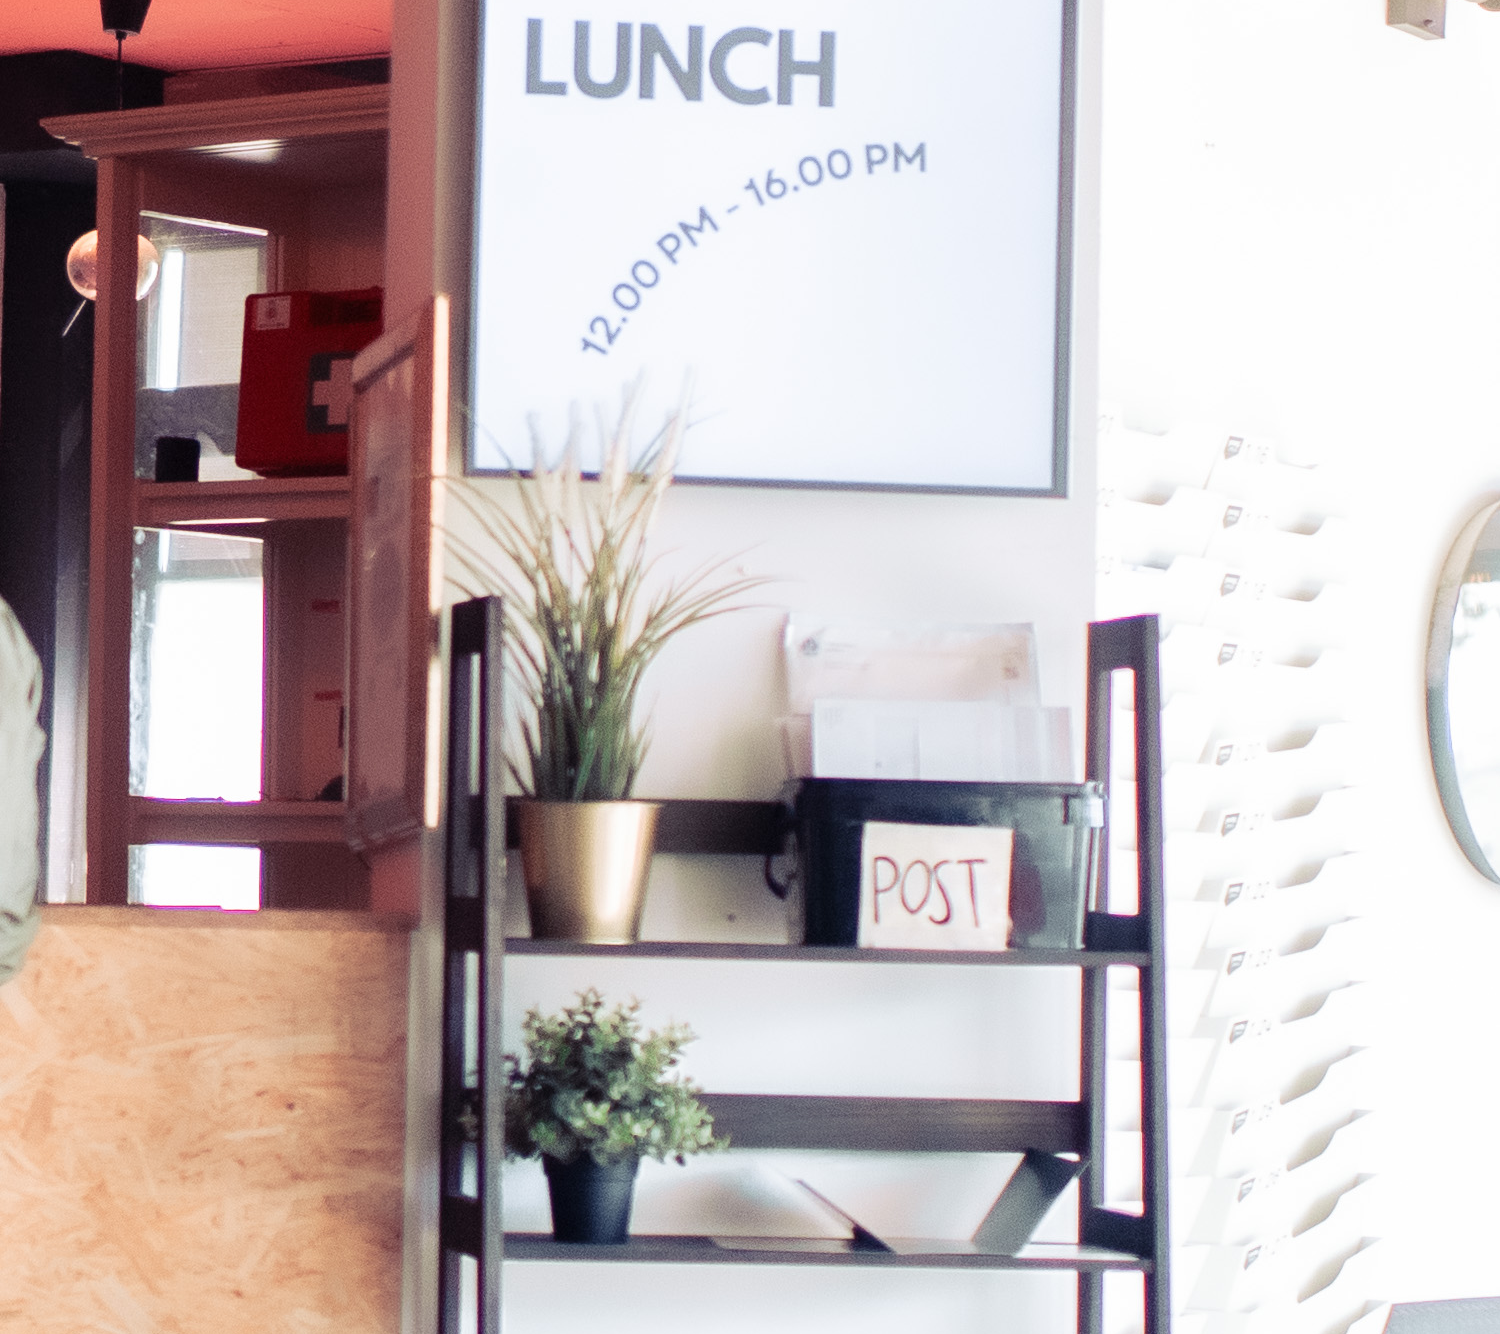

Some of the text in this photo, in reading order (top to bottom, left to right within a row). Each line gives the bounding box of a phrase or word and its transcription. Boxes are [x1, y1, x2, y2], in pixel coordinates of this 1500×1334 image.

[525, 18, 836, 107] LUNCH
[578, 259, 662, 357] 12.00
[656, 205, 720, 267] PM
[742, 148, 853, 208] 16.00
[865, 142, 928, 176] PM
[872, 856, 988, 929] POST
